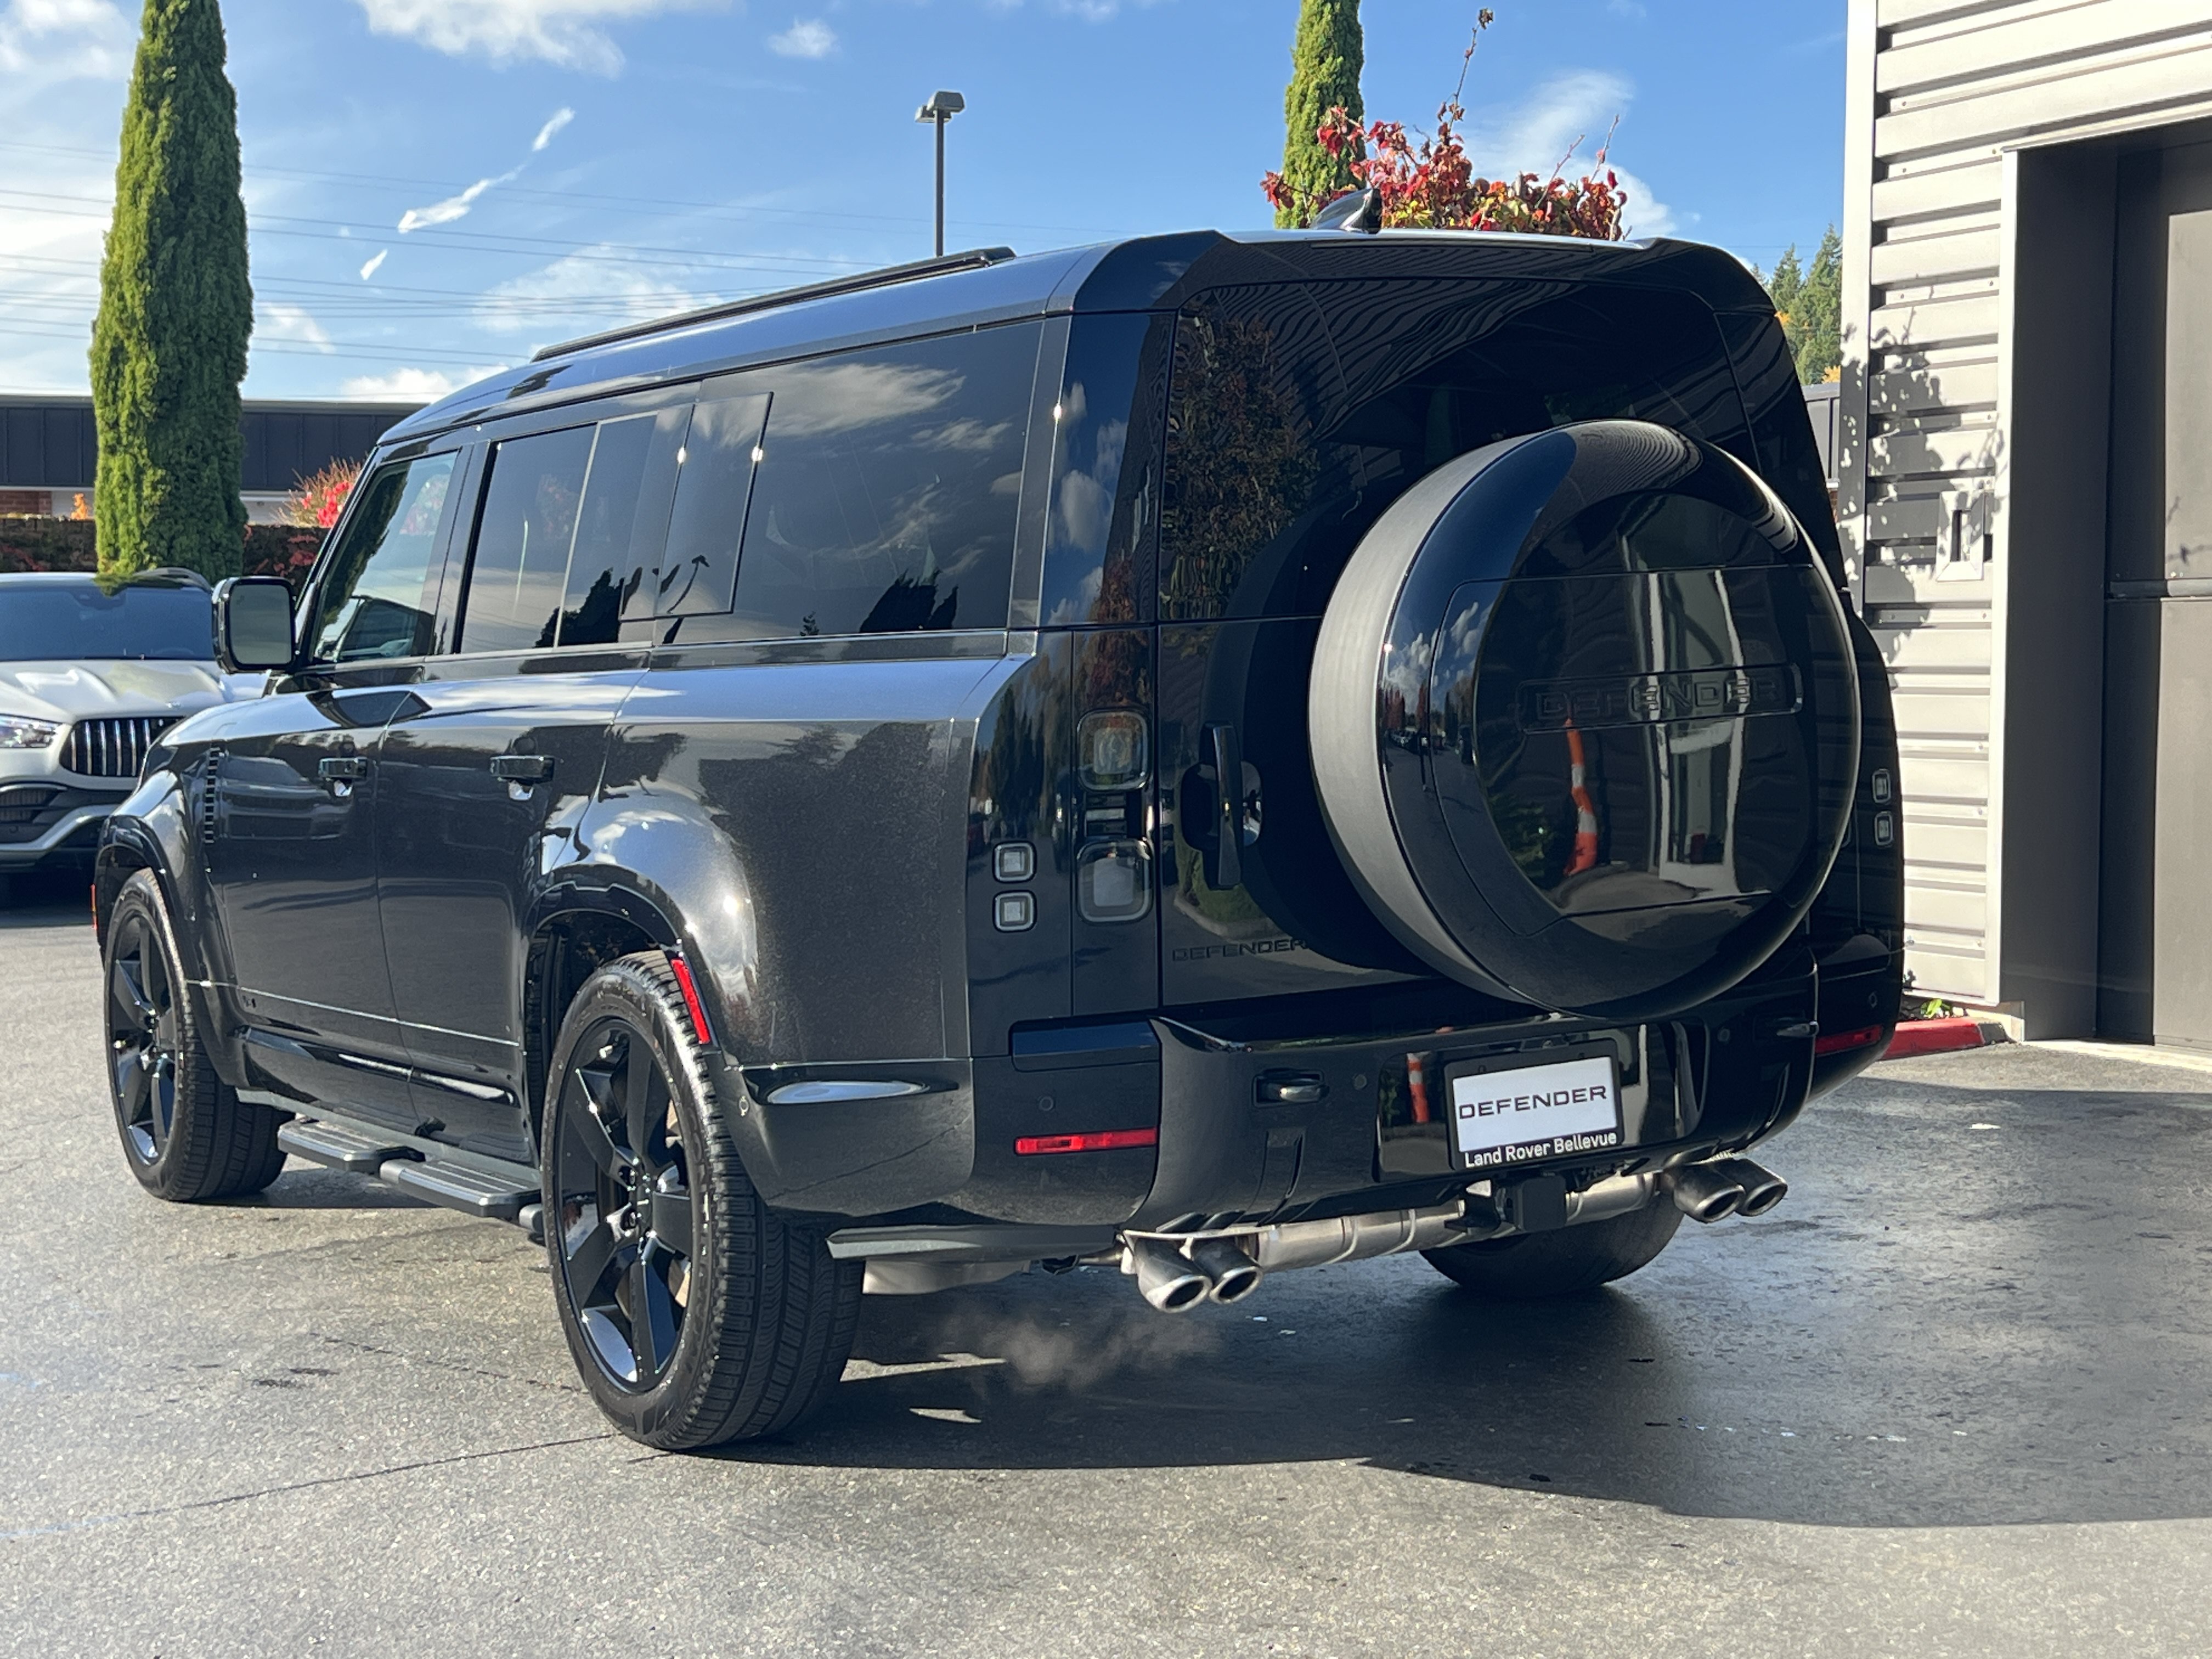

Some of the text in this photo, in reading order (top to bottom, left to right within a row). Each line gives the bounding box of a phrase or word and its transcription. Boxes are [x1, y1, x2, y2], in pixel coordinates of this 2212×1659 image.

[1537, 678, 1779, 719] DEFENDER
[1172, 939, 1308, 961] DEFENDER
[1459, 1085, 1607, 1119] DEFENDER
[1465, 1132, 1617, 1168] Land Rover Bellevue
